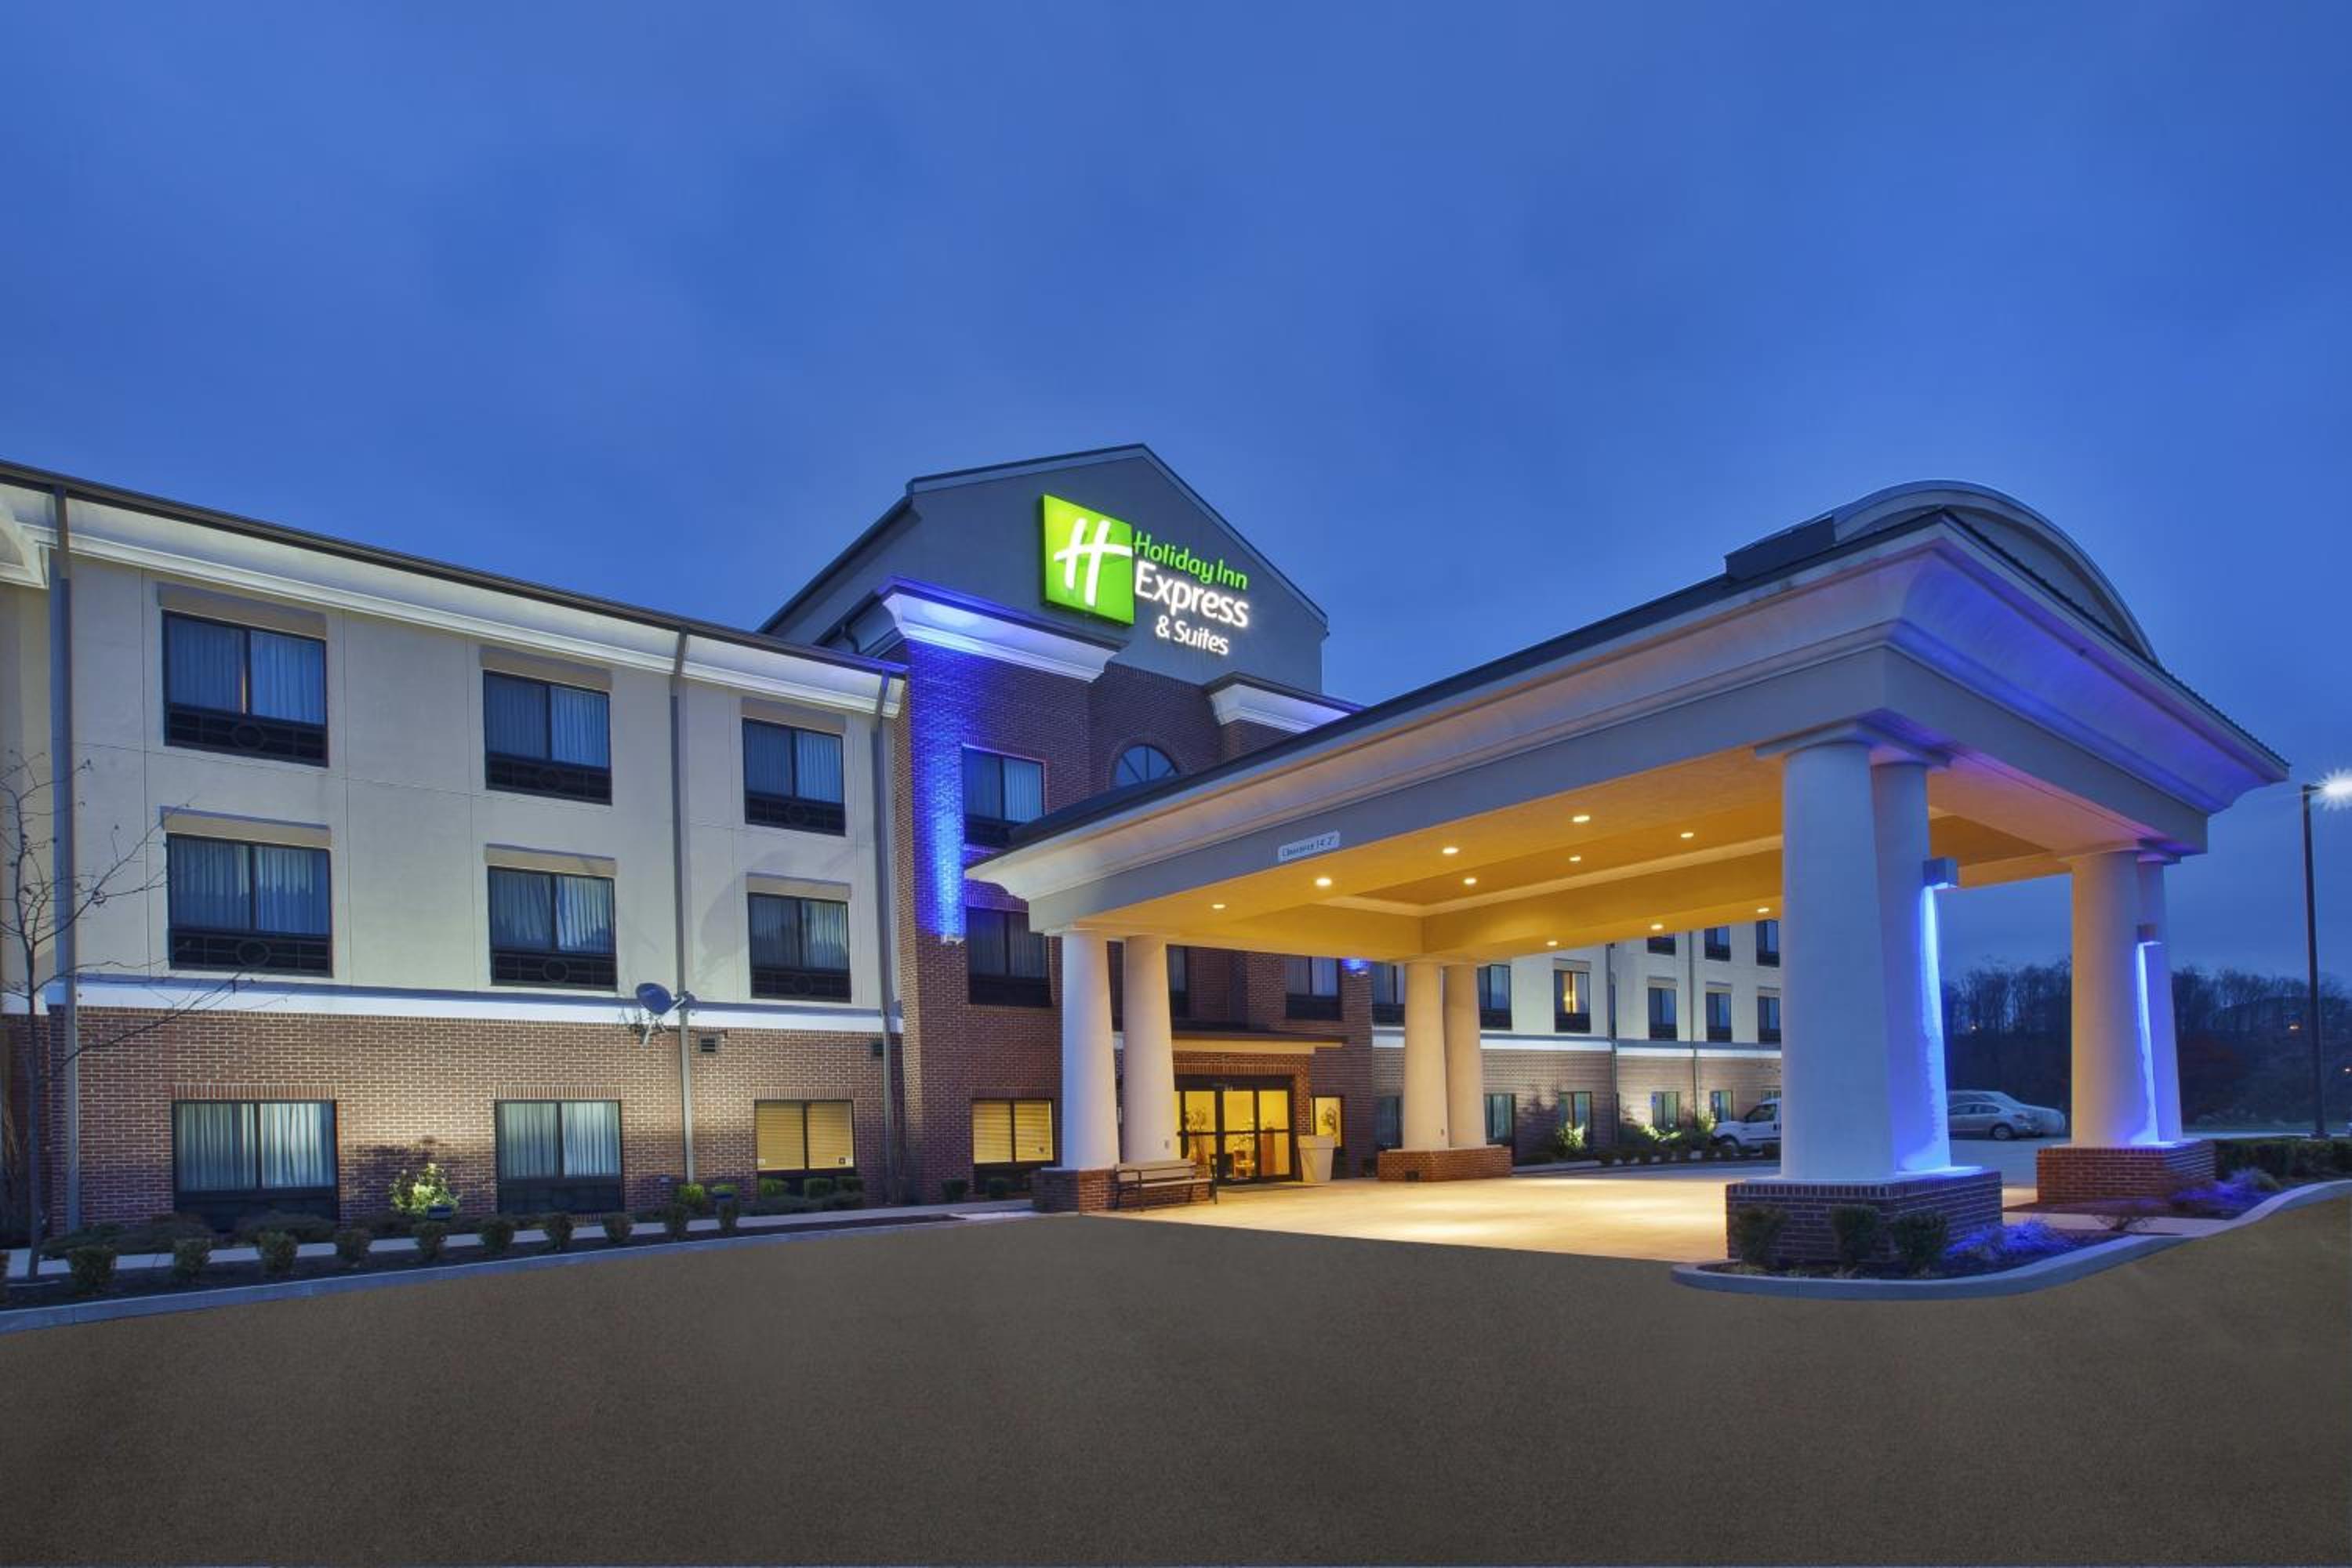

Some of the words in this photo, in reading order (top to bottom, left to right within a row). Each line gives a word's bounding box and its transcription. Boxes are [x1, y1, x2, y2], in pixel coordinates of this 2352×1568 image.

[1134, 530, 1214, 584] Holiday
[1216, 559, 1248, 590] Inn
[1134, 560, 1249, 628] Express
[1155, 615, 1170, 640] &
[1174, 619, 1229, 655] Suites
